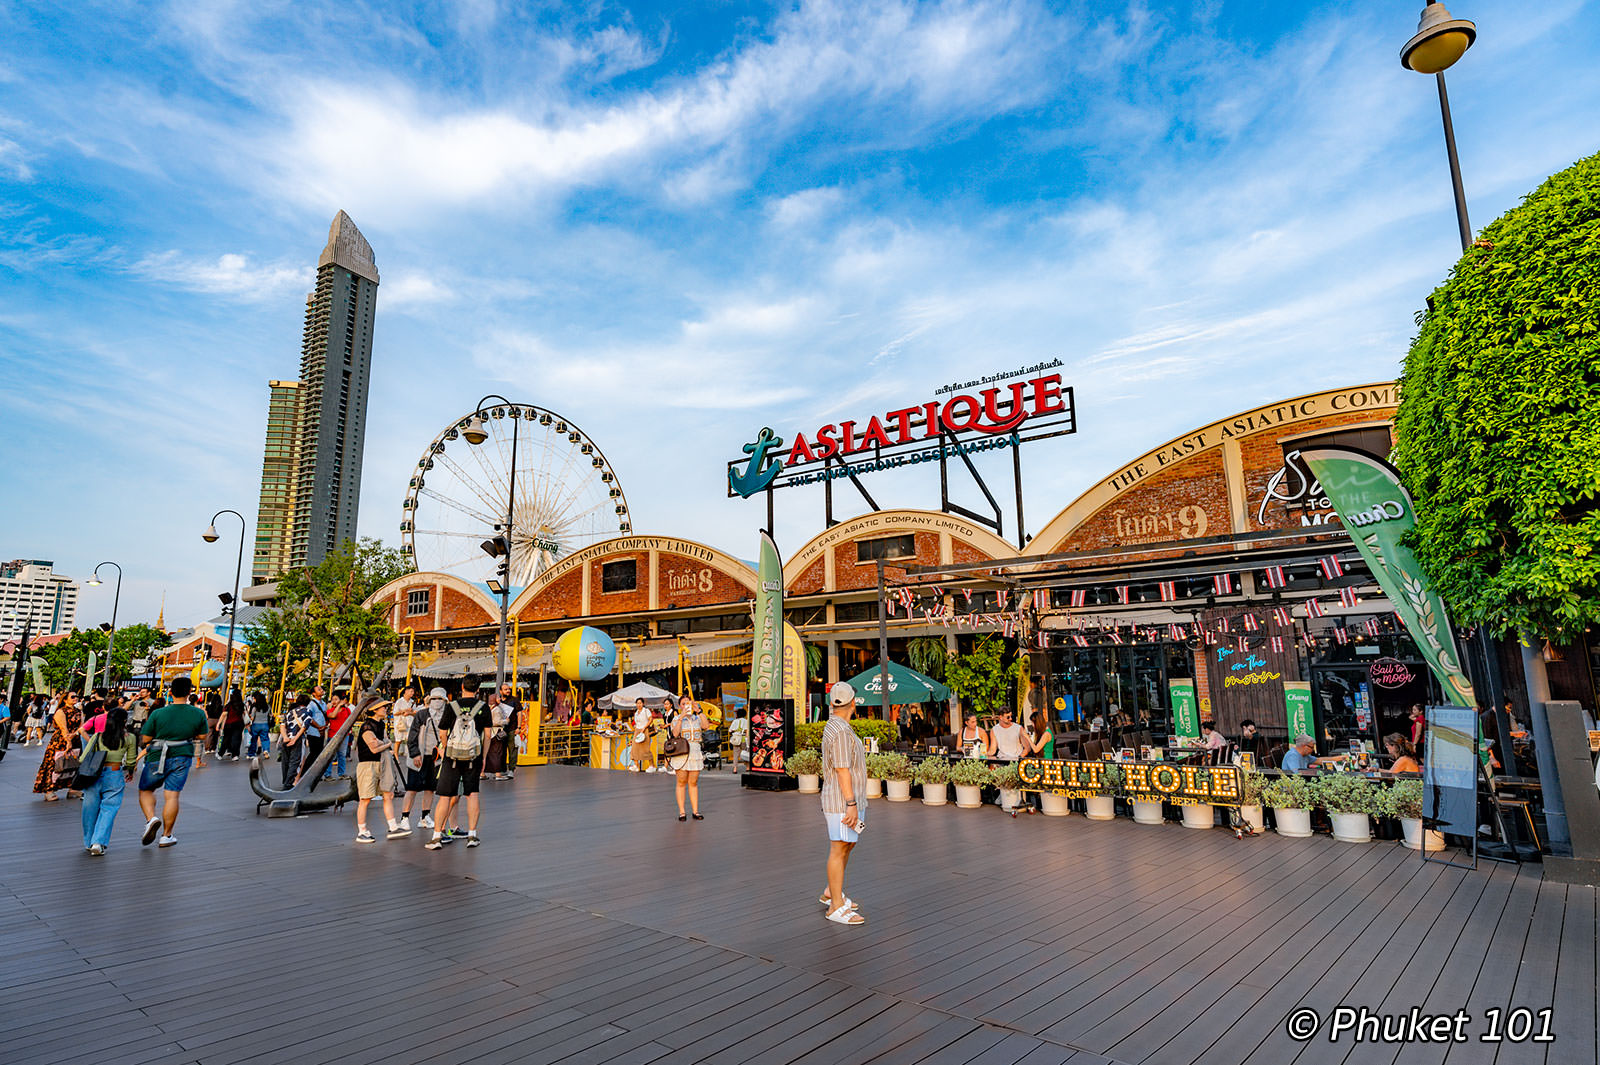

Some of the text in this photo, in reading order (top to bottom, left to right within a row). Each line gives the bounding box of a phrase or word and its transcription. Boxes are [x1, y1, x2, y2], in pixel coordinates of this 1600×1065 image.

[785, 373, 1066, 466] ASIATIQUE
[1107, 463, 1149, 492] THE
[1156, 432, 1208, 466] EAST
[1220, 400, 1317, 441] ASIATIC
[787, 434, 1022, 488] THE RIVERFRONT DESTINATION
[1306, 496, 1333, 510] TO
[1113, 505, 1208, 539] โกดัง 9
[532, 538, 559, 554] Chang
[801, 516, 974, 560] THE EAST ASIATIC COMPANY LIMITED
[540, 538, 715, 586] THE EAST ASIATIC COMPANY LIMITED
[668, 569, 714, 593] โกดัง 8
[1224, 671, 1280, 688] moon
[1373, 663, 1394, 675] Sail
[1382, 673, 1416, 684] moon
[1172, 690, 1193, 698] Chang
[1287, 694, 1310, 702] Chang
[1018, 758, 1239, 798] CHIT HOLE
[1052, 788, 1199, 808] ORIGINAL CRAFT BEER
